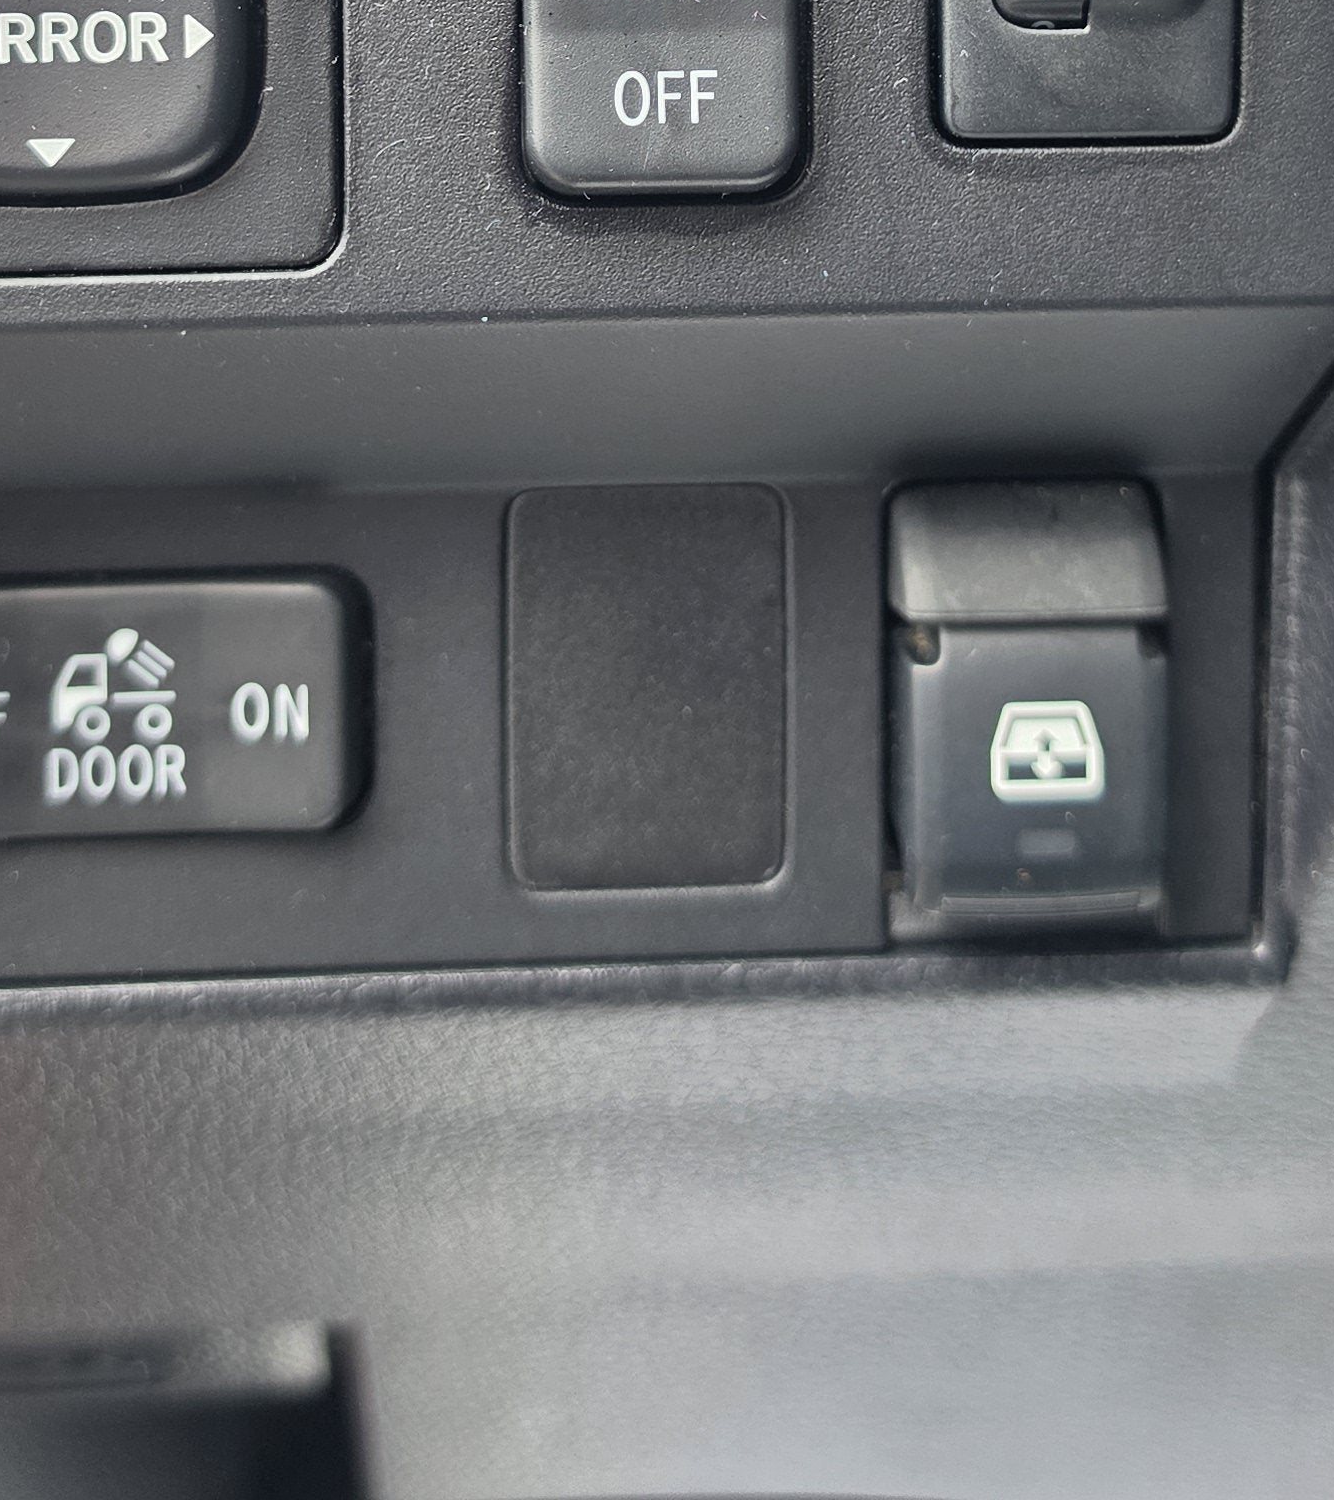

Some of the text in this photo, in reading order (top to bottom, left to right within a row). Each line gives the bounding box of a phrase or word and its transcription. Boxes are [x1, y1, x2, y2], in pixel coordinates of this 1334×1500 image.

[613, 68, 719, 127] OFF
[229, 681, 310, 745] ON
[44, 743, 187, 806] DOOR
